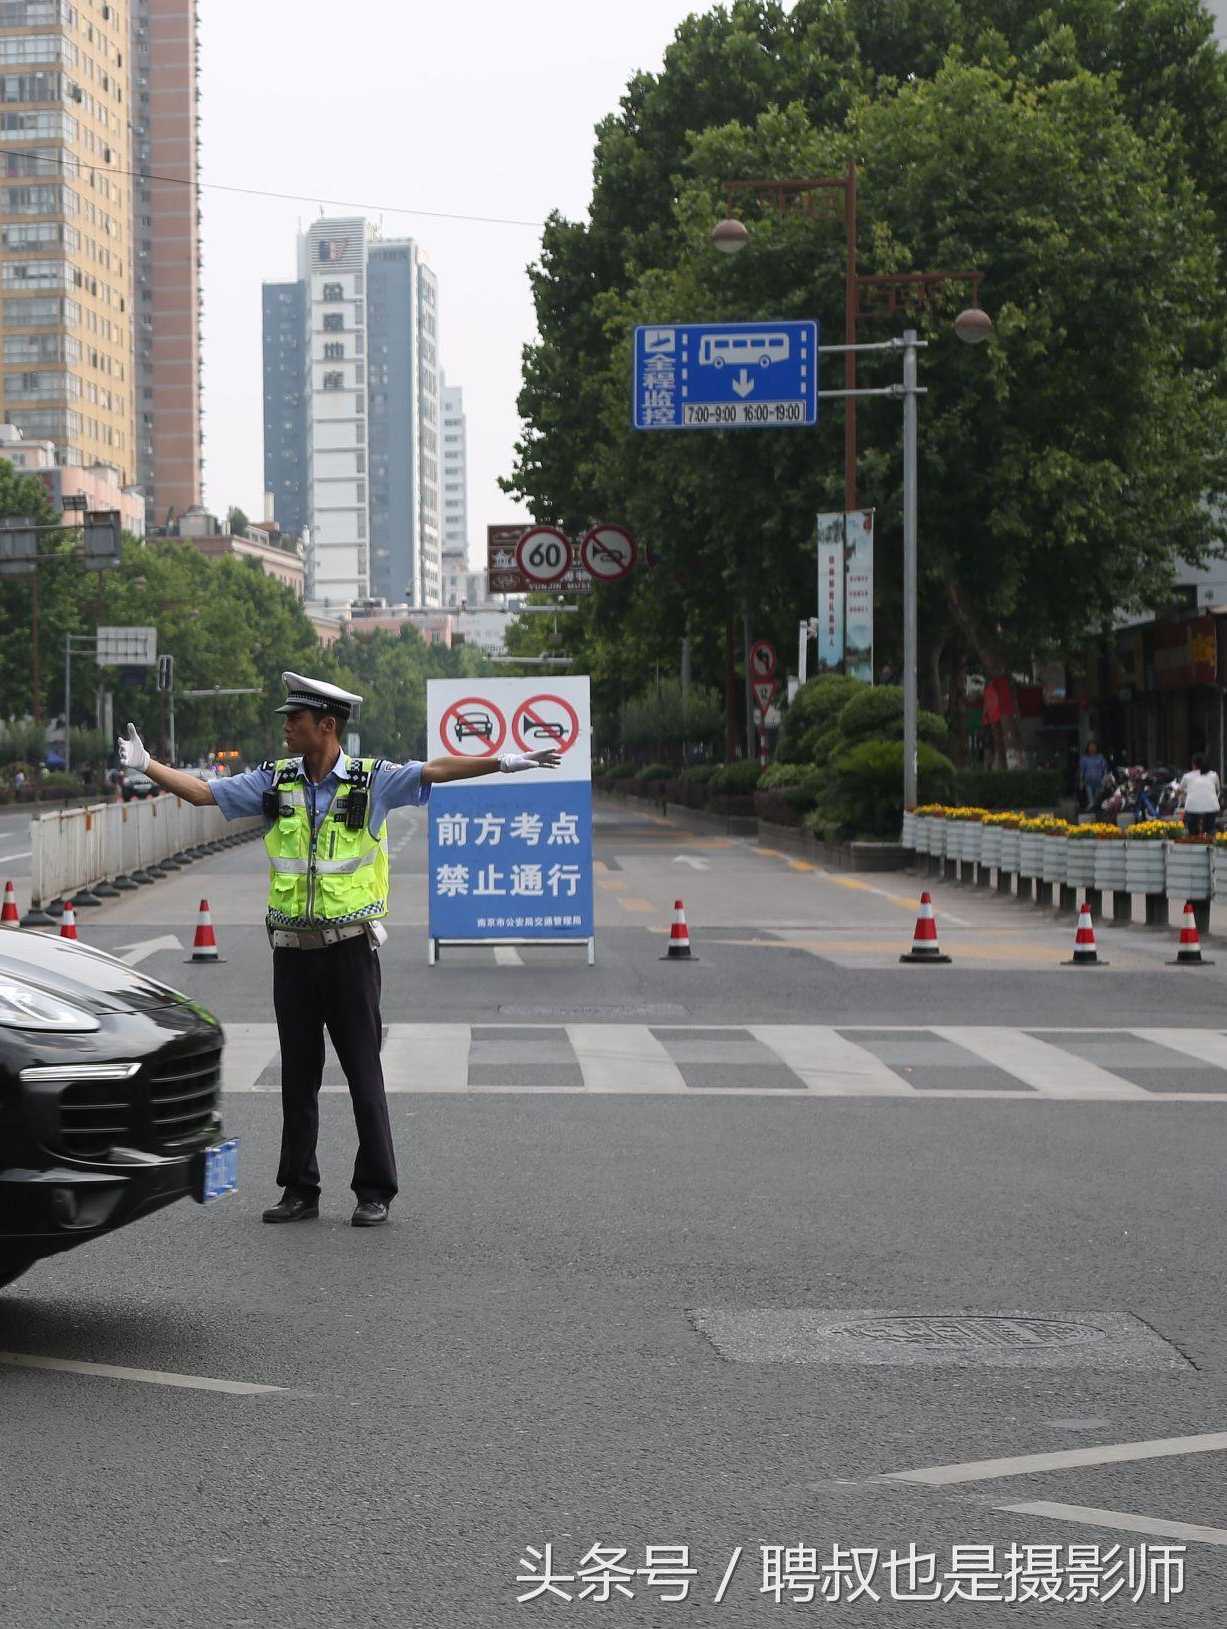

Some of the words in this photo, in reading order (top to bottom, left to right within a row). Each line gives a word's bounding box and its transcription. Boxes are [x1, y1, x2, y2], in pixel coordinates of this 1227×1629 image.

[643, 353, 676, 425] 全程监控
[688, 406, 737, 422] 7:00-9:00
[743, 404, 800, 421] 16:00-19:00
[529, 543, 562, 567] 60
[436, 811, 580, 847] 前方考点
[437, 863, 581, 897] 禁止通行
[477, 915, 582, 928] 南京市公安局交通管理局
